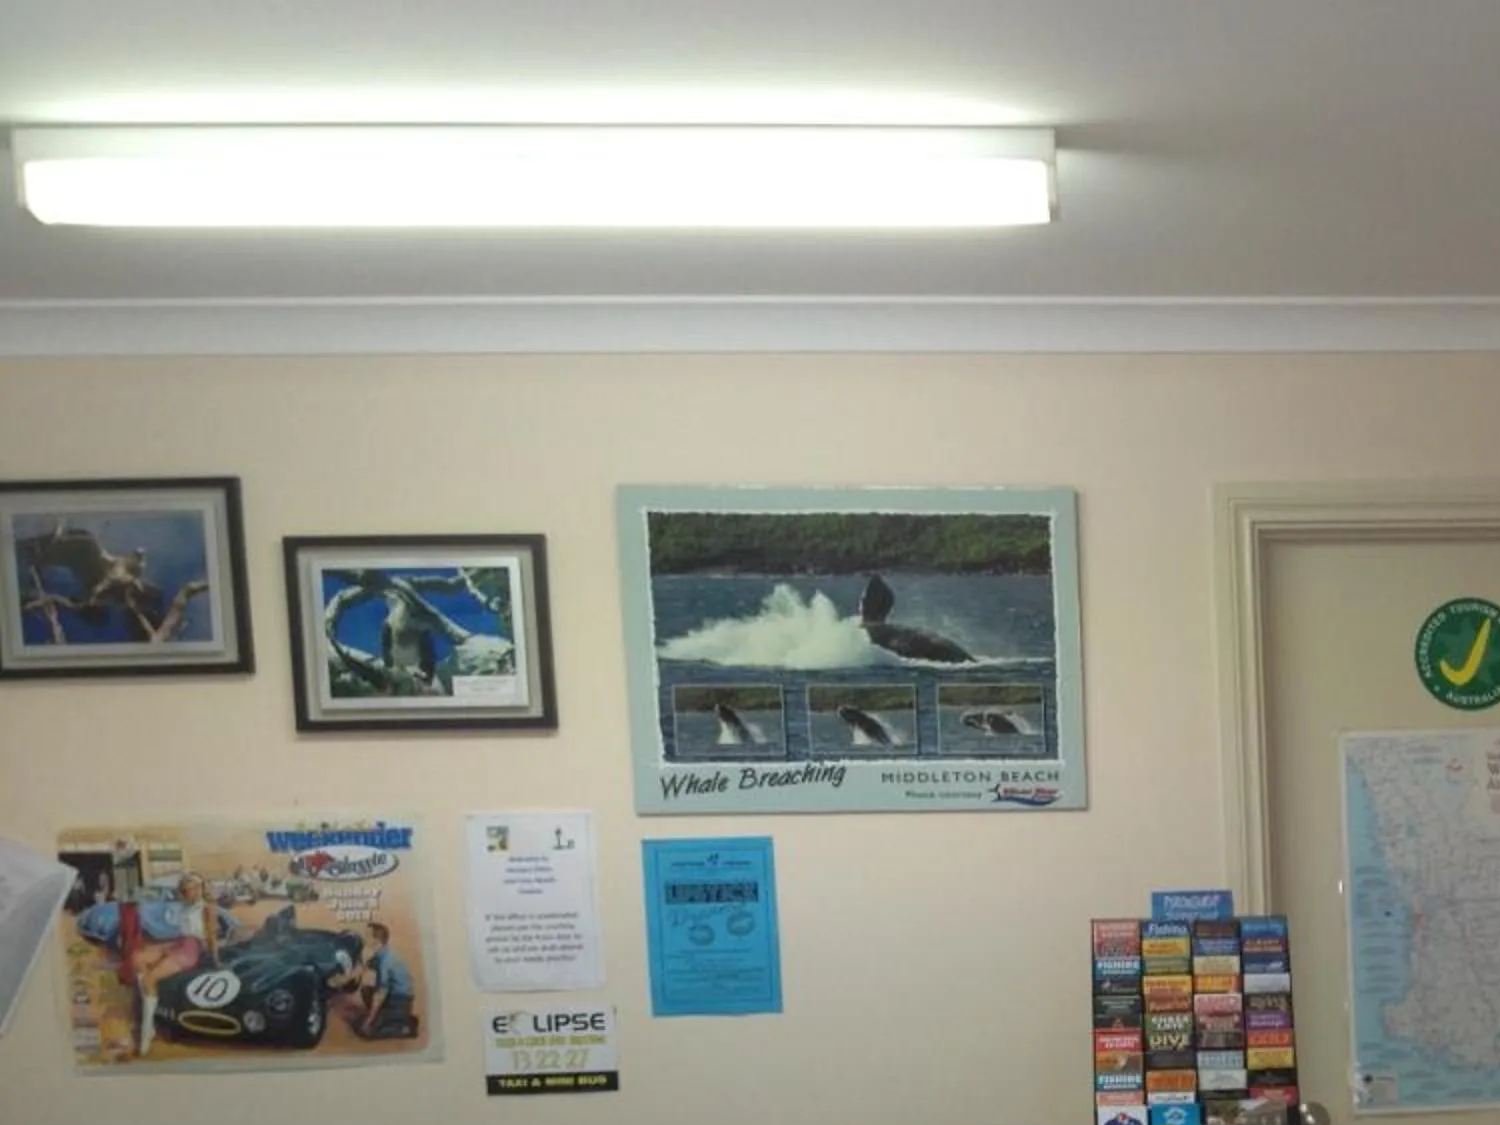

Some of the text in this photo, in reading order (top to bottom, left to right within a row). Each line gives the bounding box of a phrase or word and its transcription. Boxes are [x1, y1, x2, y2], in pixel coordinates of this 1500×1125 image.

[660, 763, 1060, 800] Whale Breaching MIDDLETON BEACH
[194, 975, 229, 1002] 10
